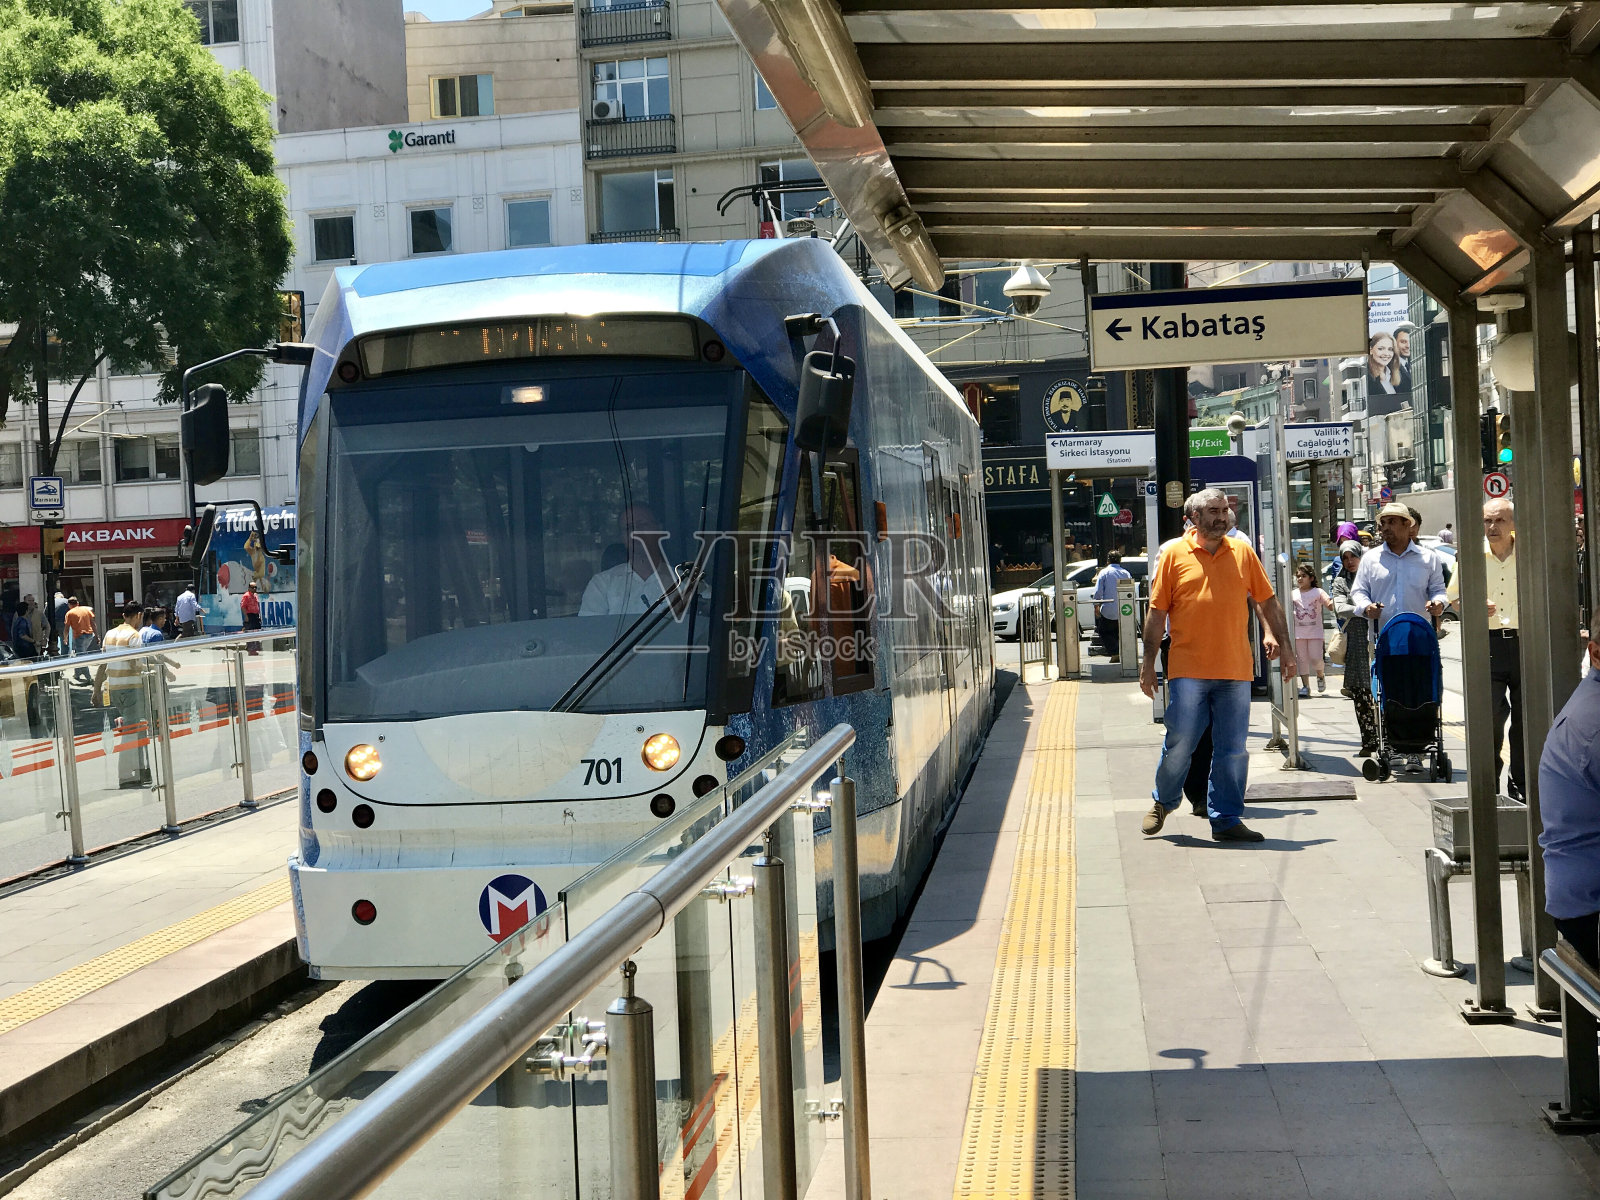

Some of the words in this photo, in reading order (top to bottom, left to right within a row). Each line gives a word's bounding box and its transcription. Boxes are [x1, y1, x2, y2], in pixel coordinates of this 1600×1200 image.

[404, 129, 456, 147] Garanti
[1141, 312, 1266, 341] Kabataş
[1314, 428, 1341, 437] Valilik
[1059, 439, 1103, 448] Marmaray
[1297, 438, 1341, 449] Cağaloğlu
[1059, 449, 1088, 457] Sirkeci
[1089, 447, 1131, 457] İstasyonu
[1286, 449, 1306, 459] Milli
[984, 464, 1040, 486] STAFA
[1102, 502, 1114, 513] 20
[66, 527, 156, 544] AKBANK
[580, 757, 622, 786] 701
